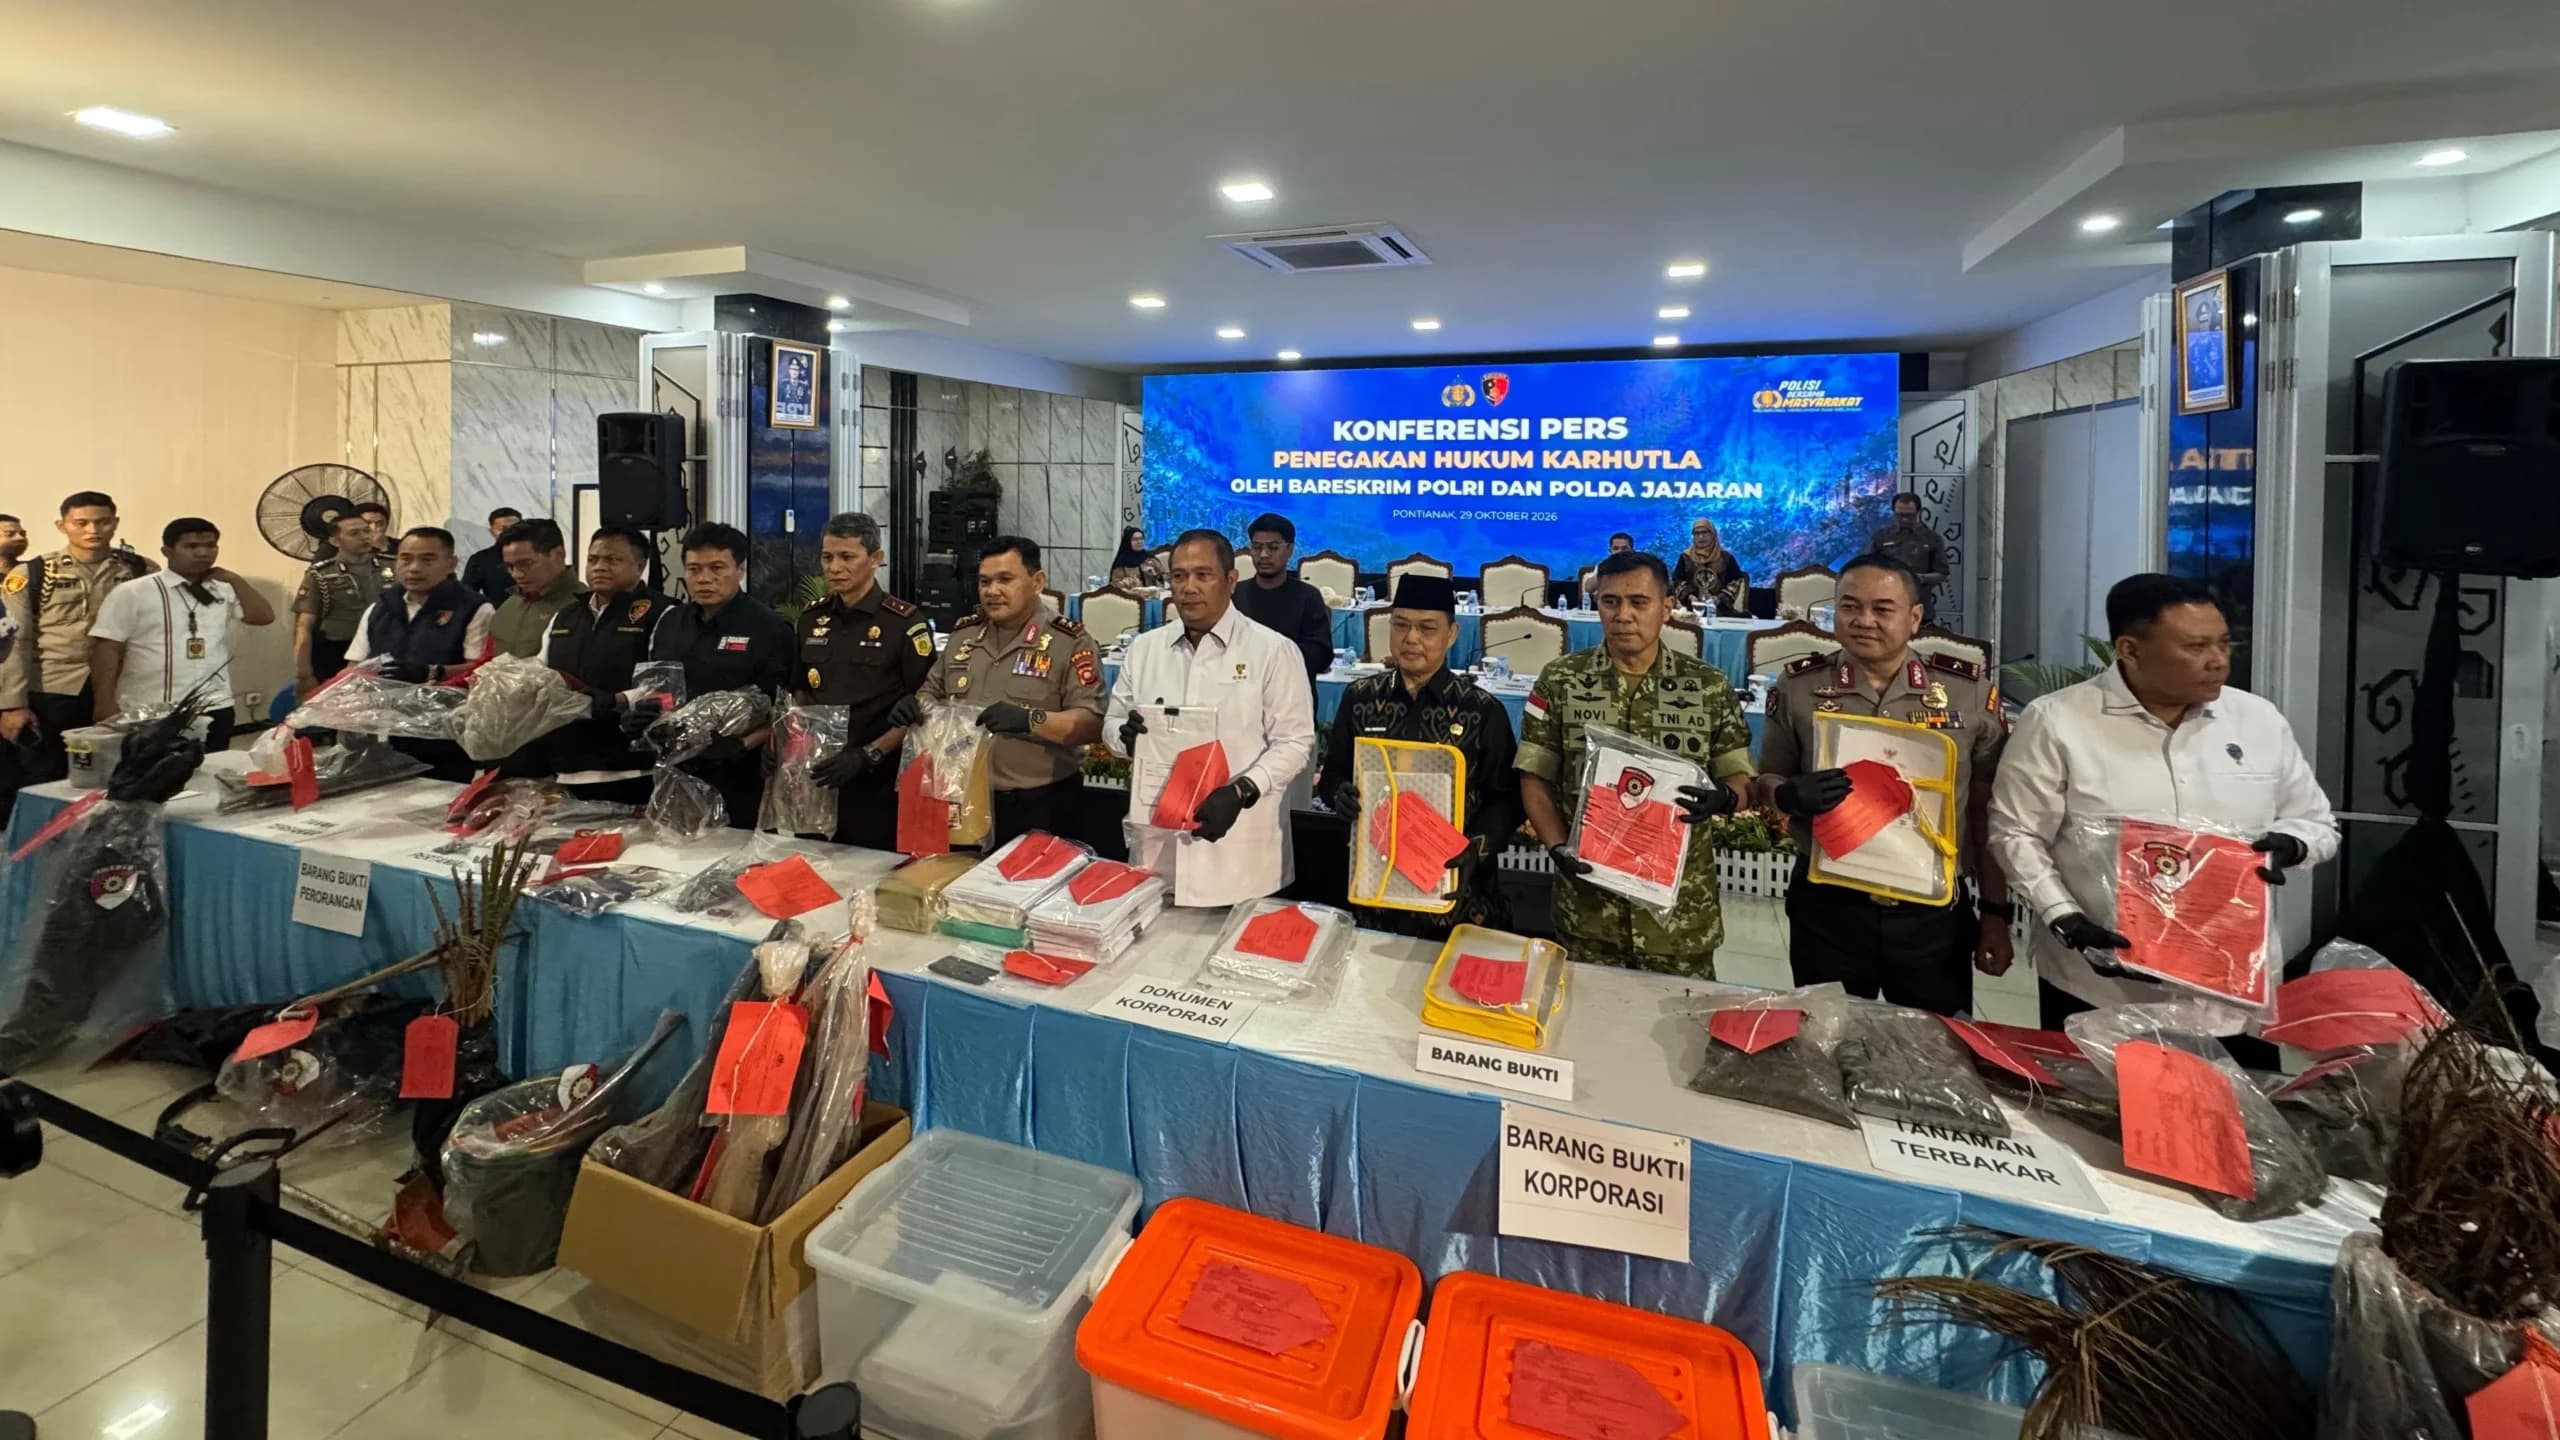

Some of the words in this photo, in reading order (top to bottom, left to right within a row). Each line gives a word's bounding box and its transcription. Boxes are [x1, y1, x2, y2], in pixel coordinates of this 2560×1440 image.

[1779, 380, 1822, 391] POLISI
[1782, 397, 1864, 408] MASYARAKAT
[1333, 418, 1530, 441] KONFERENSI
[1540, 417, 1629, 440] PERS
[1273, 450, 1426, 469] PENEGAKAN
[1434, 450, 1534, 469] HUKUM
[1542, 450, 1702, 470] KARHUTLA
[1230, 478, 1283, 493] OLEH
[1288, 479, 1412, 495] BARESKRIM
[1417, 480, 1484, 496] POLRI
[1491, 480, 1542, 497] DAN
[1550, 481, 1635, 498] POLDA
[1641, 482, 1763, 499] JAJARAN
[1392, 509, 1457, 520] PONTIANAK,
[1460, 510, 1473, 520] 29
[1475, 511, 1529, 521] OKTOBER
[1531, 511, 1558, 522] 2026
[1573, 709, 1606, 721] NOVI
[1658, 713, 1680, 725] TNI
[1687, 715, 1705, 727] AD
[301, 862, 336, 883] BARANG
[338, 871, 368, 889] BUKTI
[300, 886, 363, 912] PERORANGAN
[1139, 984, 1233, 1011] DOKUMEN
[1115, 996, 1229, 1028] KORPORASI
[1431, 1047, 1502, 1072] BARANG
[1507, 1062, 1559, 1083] BUKTI
[1506, 1124, 1605, 1164] BARANG
[1612, 1148, 1685, 1182] BUKTI
[1890, 1138, 2062, 1186] TERBAKAR
[1524, 1168, 1664, 1215] KORPORASI
